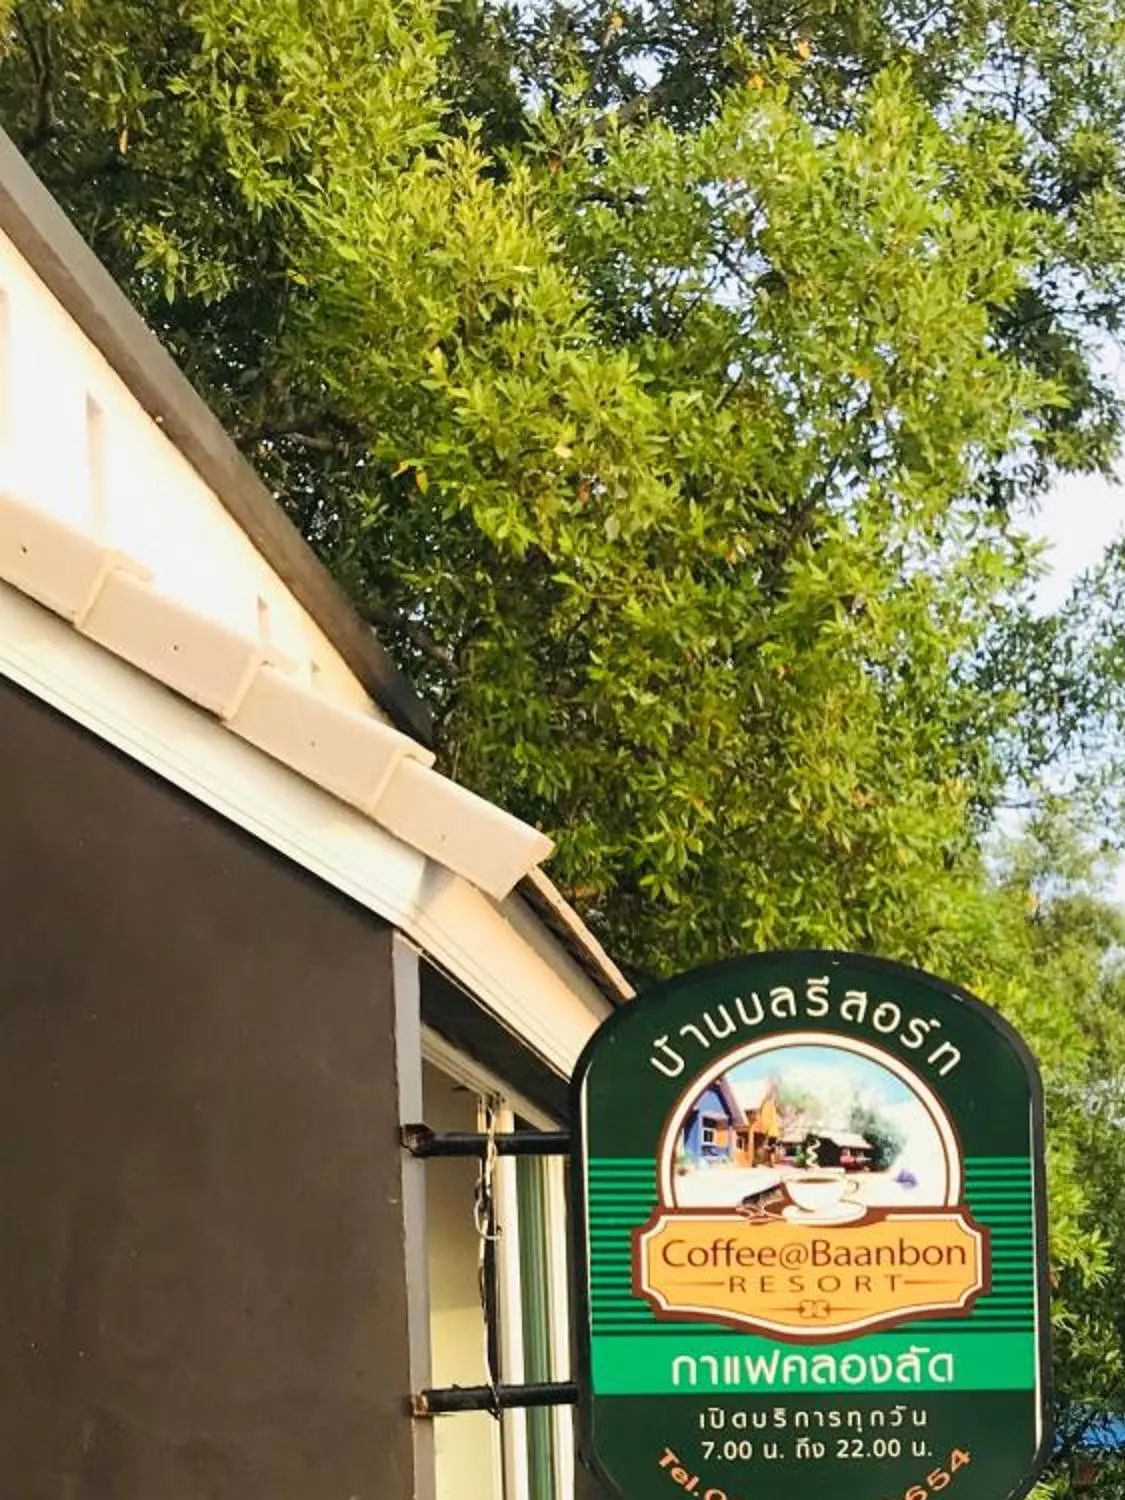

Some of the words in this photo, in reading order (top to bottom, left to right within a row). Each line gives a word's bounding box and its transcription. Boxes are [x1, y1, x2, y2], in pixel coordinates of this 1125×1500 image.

[661, 1238, 967, 1270] Coffee@Baanbon
[728, 1274, 902, 1294] RESORT
[671, 1344, 955, 1386] กาแฟคลองลัด
[701, 1440, 753, 1460] 7.00
[836, 1438, 901, 1459] 22.00
